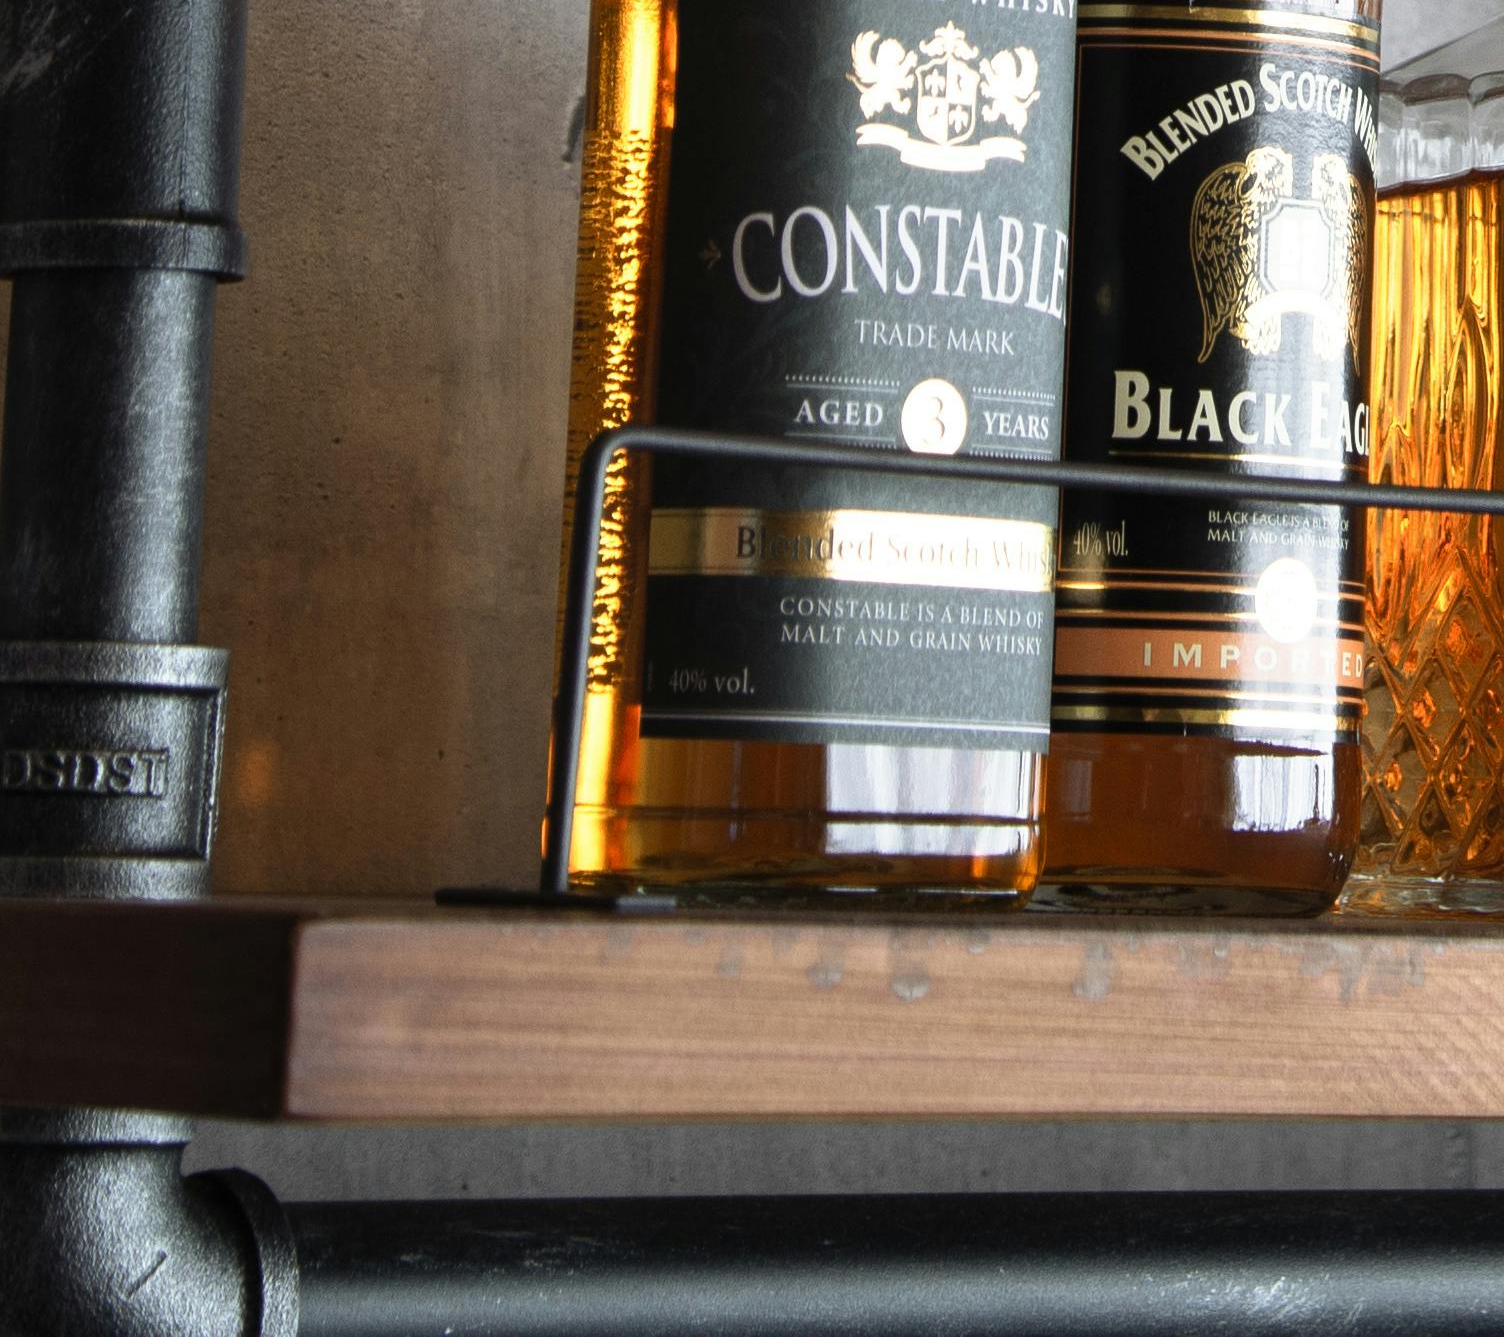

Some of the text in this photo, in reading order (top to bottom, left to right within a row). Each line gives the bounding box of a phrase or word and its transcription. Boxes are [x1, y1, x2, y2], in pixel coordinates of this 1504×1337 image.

[1120, 63, 1353, 181] BLENDED SCOTCH
[732, 203, 1070, 325] CONSTABLE
[854, 318, 1015, 356] TRADE MARK
[795, 394, 1050, 447] AGED 3 YEARS
[1110, 369, 1293, 448] BLACK
[1208, 509, 1249, 525] BLACK
[736, 524, 875, 562] Blended
[887, 533, 979, 568] Scotch
[1072, 520, 1129, 558] 40% vol.
[1207, 528, 1244, 543] MALT
[1249, 531, 1278, 545] AND
[1281, 532, 1315, 548] GRAIN
[779, 596, 1045, 631] CONSTABLE IS A BLEND OF
[780, 623, 1044, 657] MALT AND GRAIN WHISKY
[1142, 641, 1365, 680] IMPORTED
[668, 668, 709, 694] 40%
[714, 668, 756, 695] vol.
